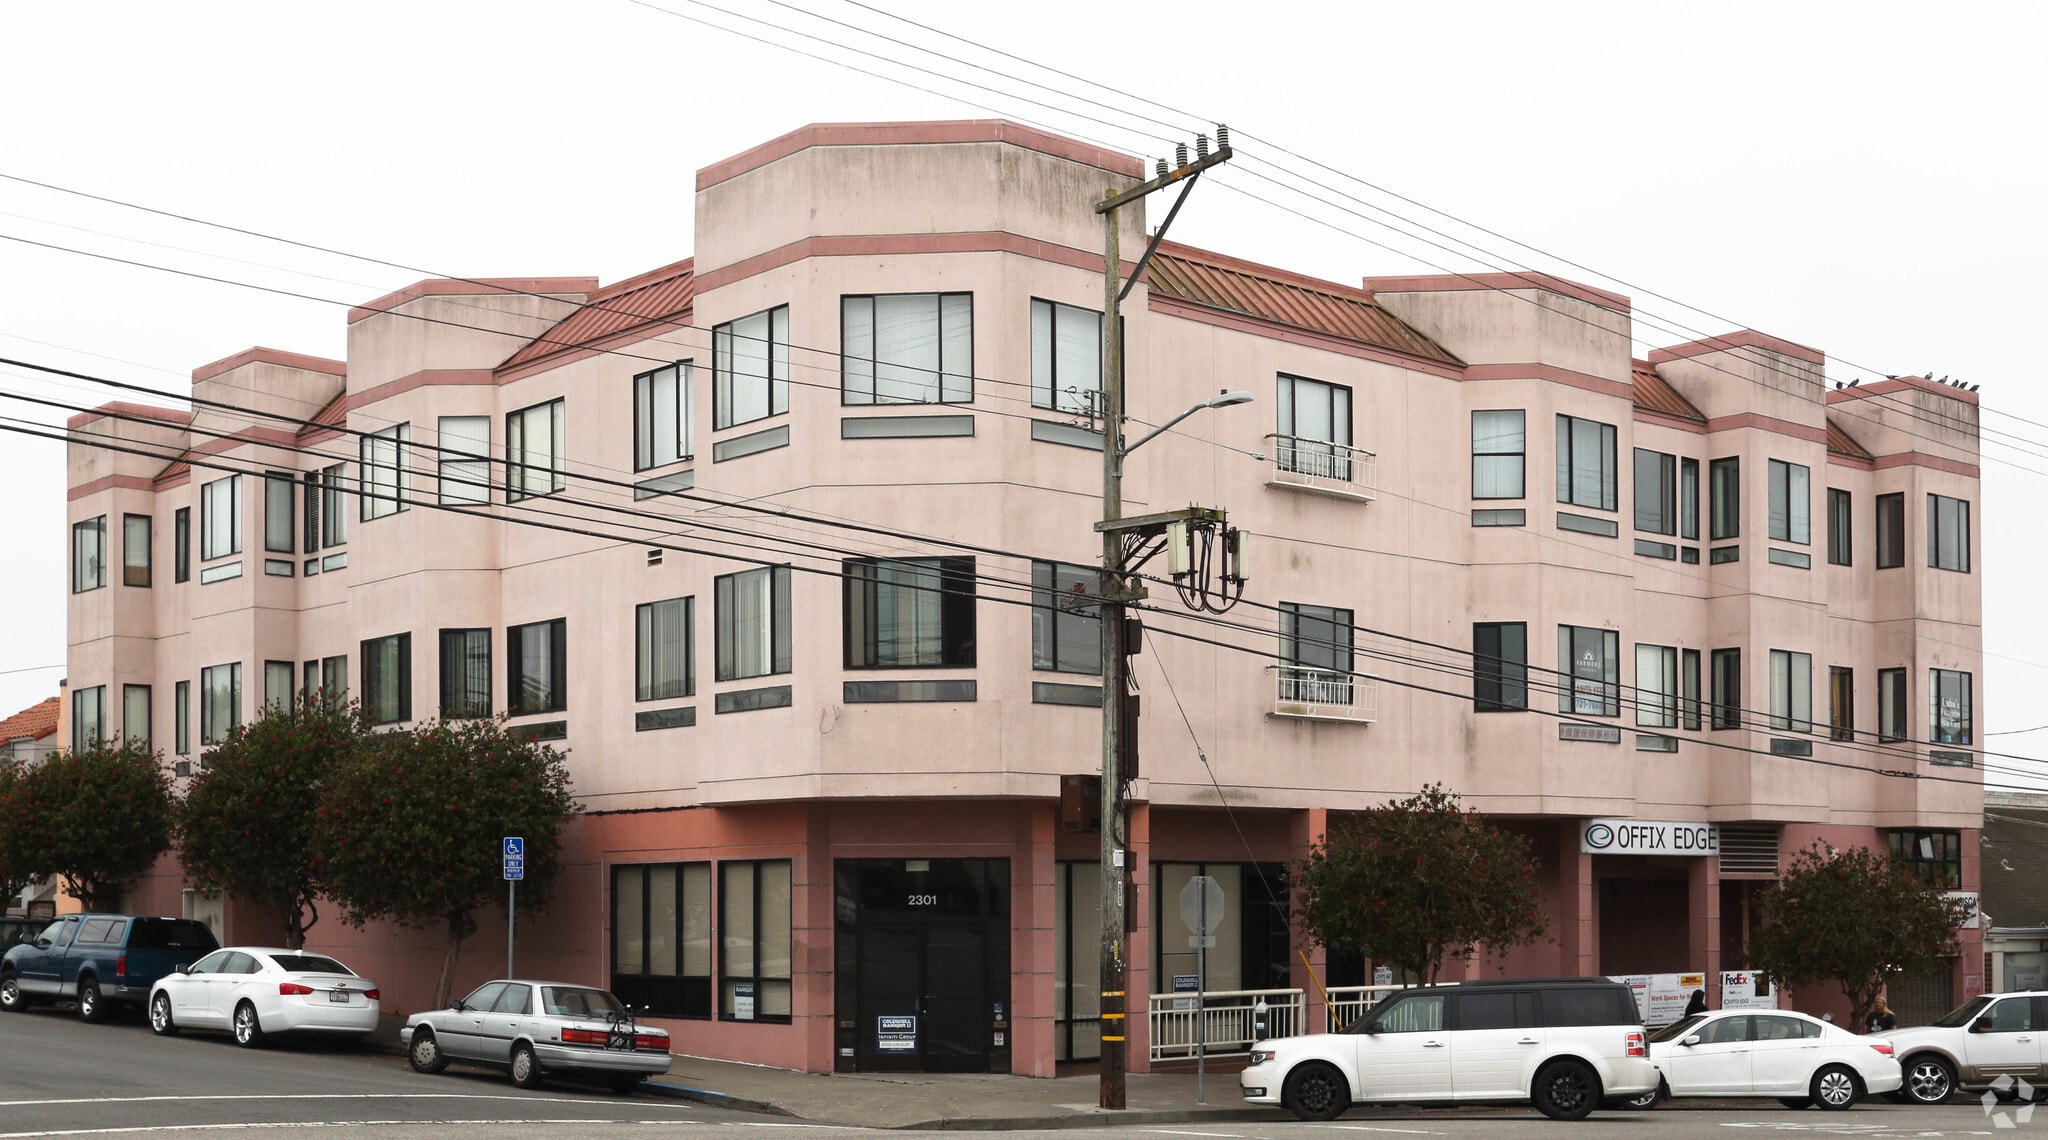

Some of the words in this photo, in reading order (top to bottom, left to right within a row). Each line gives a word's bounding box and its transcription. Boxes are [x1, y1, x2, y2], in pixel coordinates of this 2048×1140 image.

[1576, 659, 1601, 668] FARMERS
[1617, 825, 1666, 848] OFFIX
[1674, 827, 1717, 850] EDGE
[908, 895, 937, 905] 2301
[1725, 973, 1748, 985] FedEx
